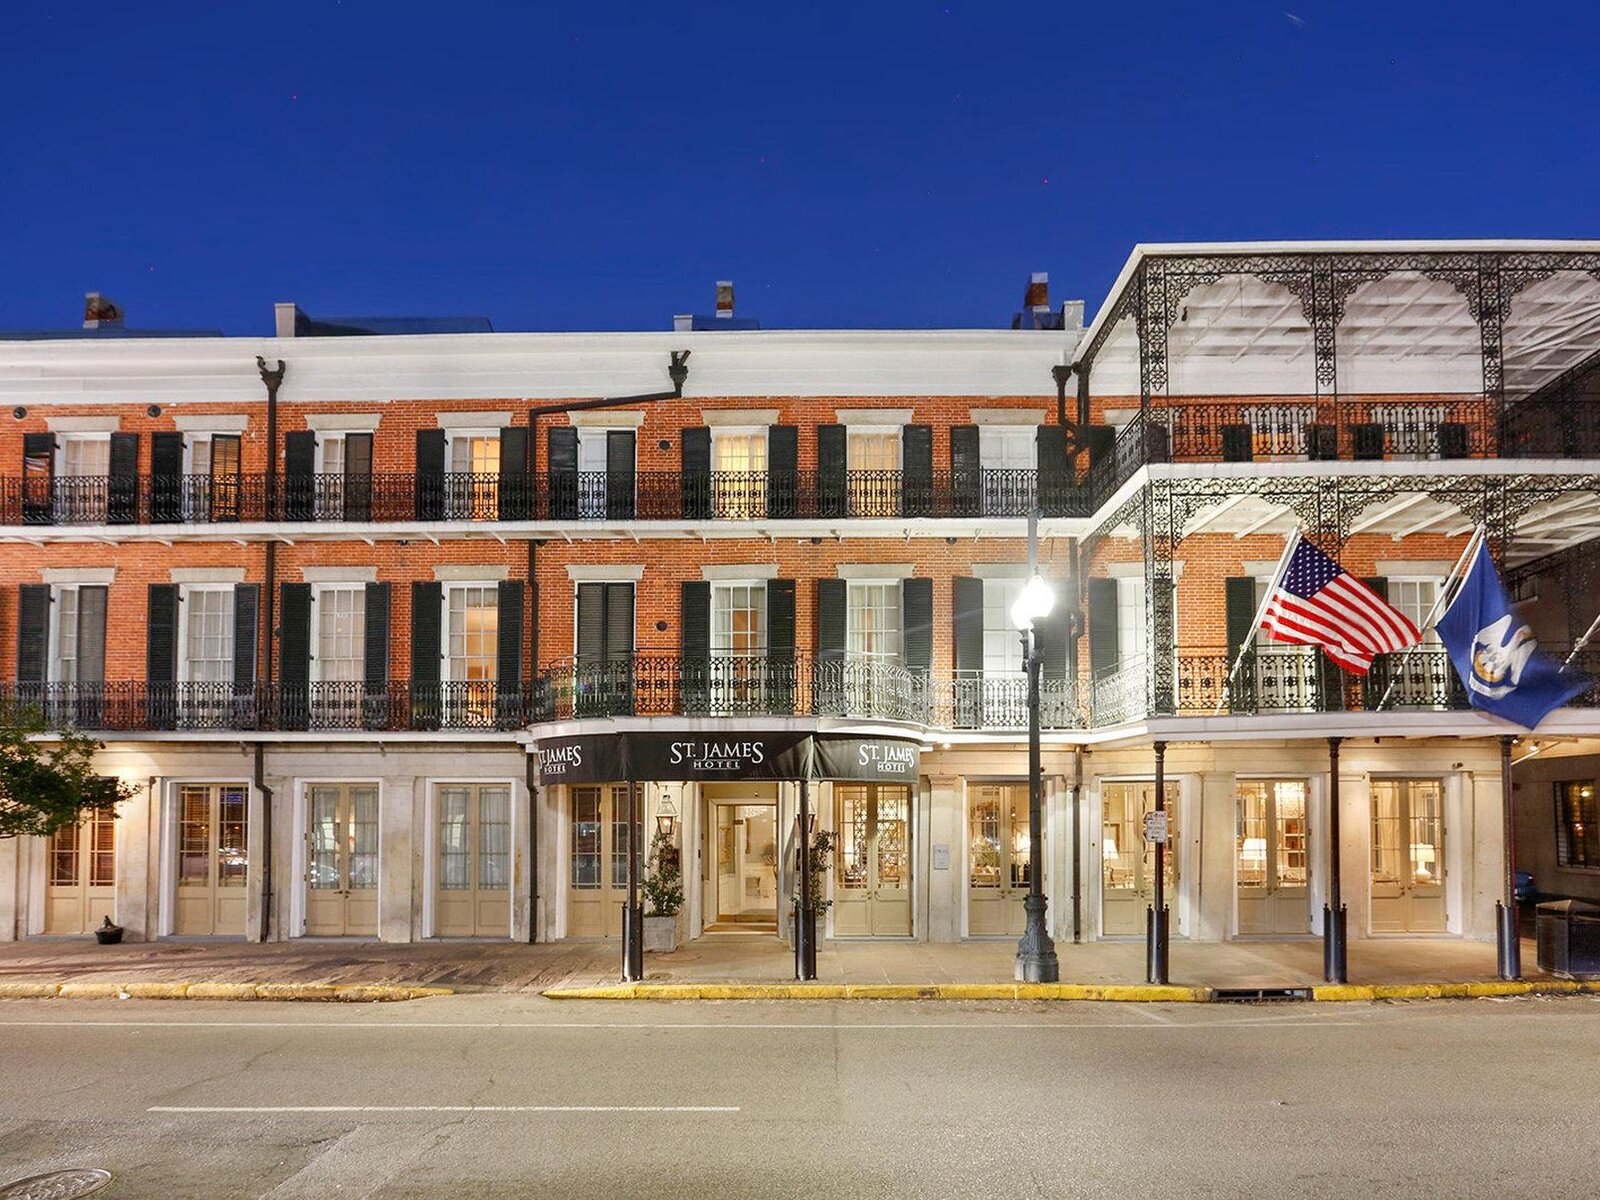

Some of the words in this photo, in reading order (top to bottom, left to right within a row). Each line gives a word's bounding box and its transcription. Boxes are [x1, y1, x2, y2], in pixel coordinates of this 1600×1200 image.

[545, 745, 582, 767] JAMES
[670, 742, 696, 764] ST.
[702, 742, 764, 764] JAMES
[858, 744, 880, 766] ST.
[884, 746, 914, 768] JAMES
[693, 760, 740, 769] HOTEL
[877, 762, 906, 772] HOTEL
